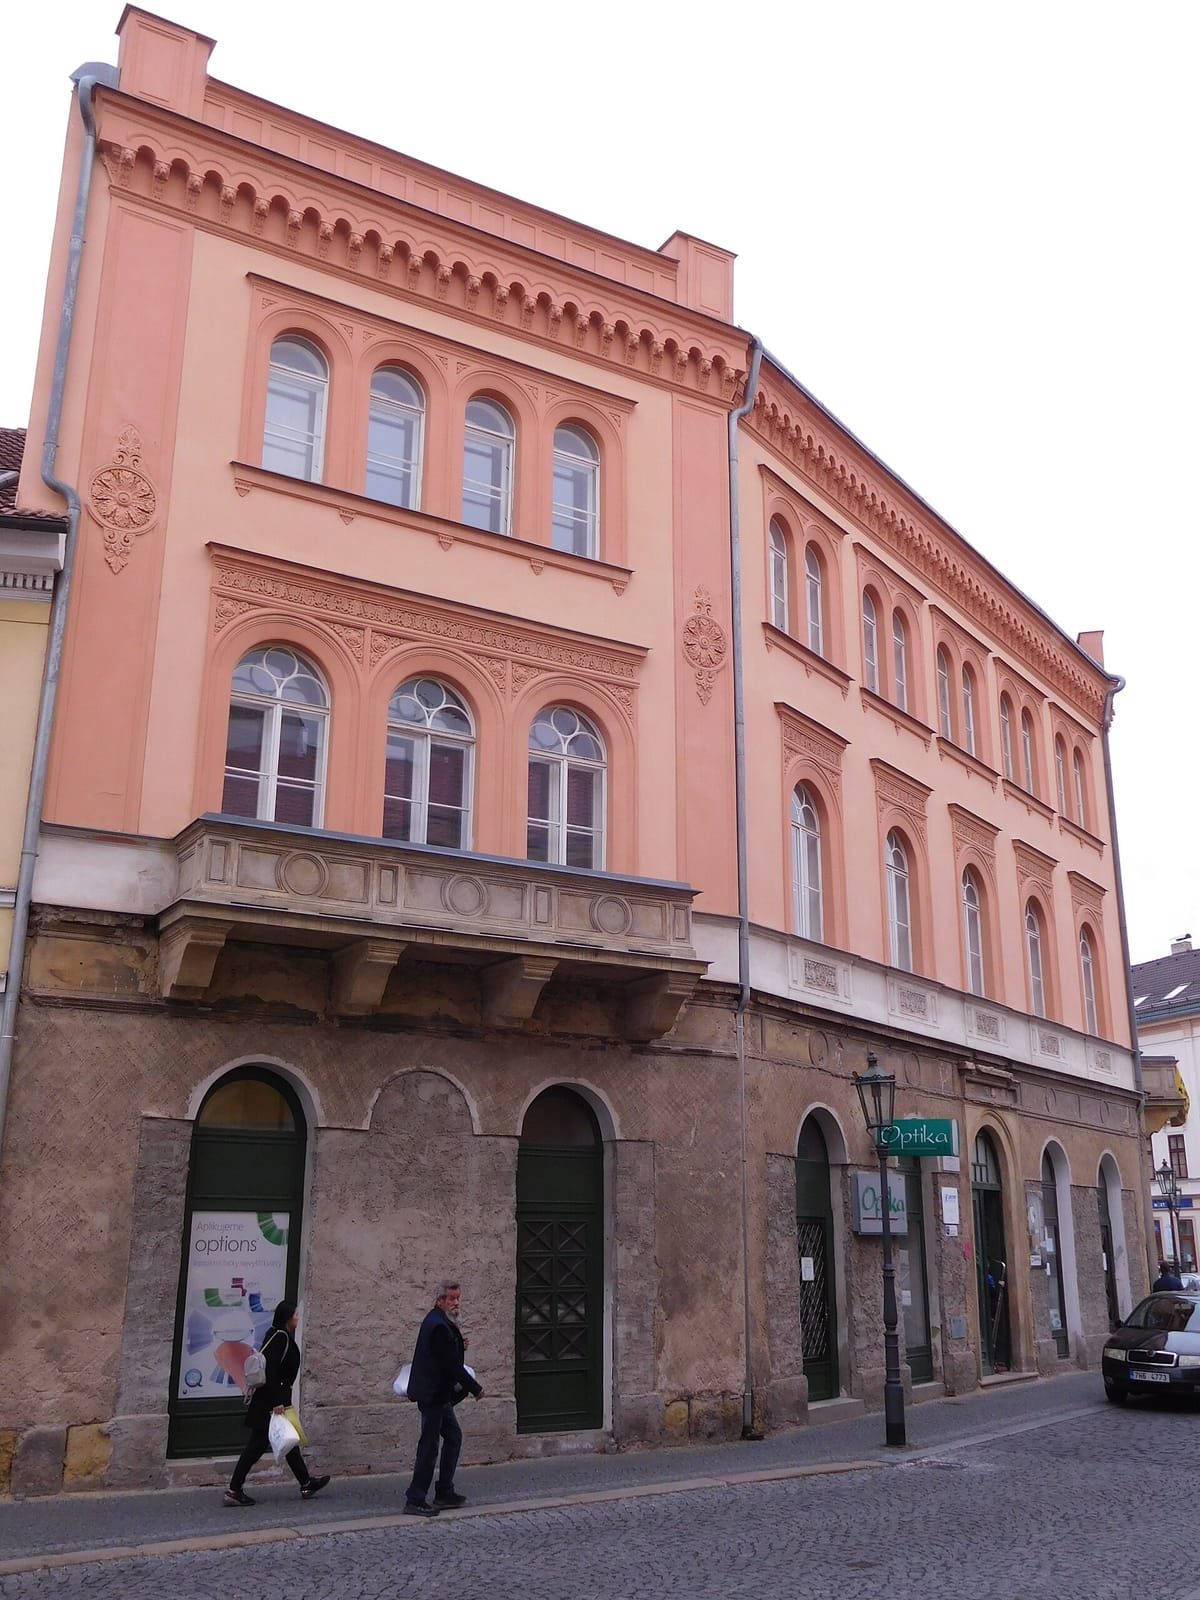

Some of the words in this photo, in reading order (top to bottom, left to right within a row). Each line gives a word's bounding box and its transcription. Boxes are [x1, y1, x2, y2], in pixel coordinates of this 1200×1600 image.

[881, 1124, 948, 1150] Optika
[862, 1186, 905, 1217] Opka
[195, 1235, 257, 1255] options
